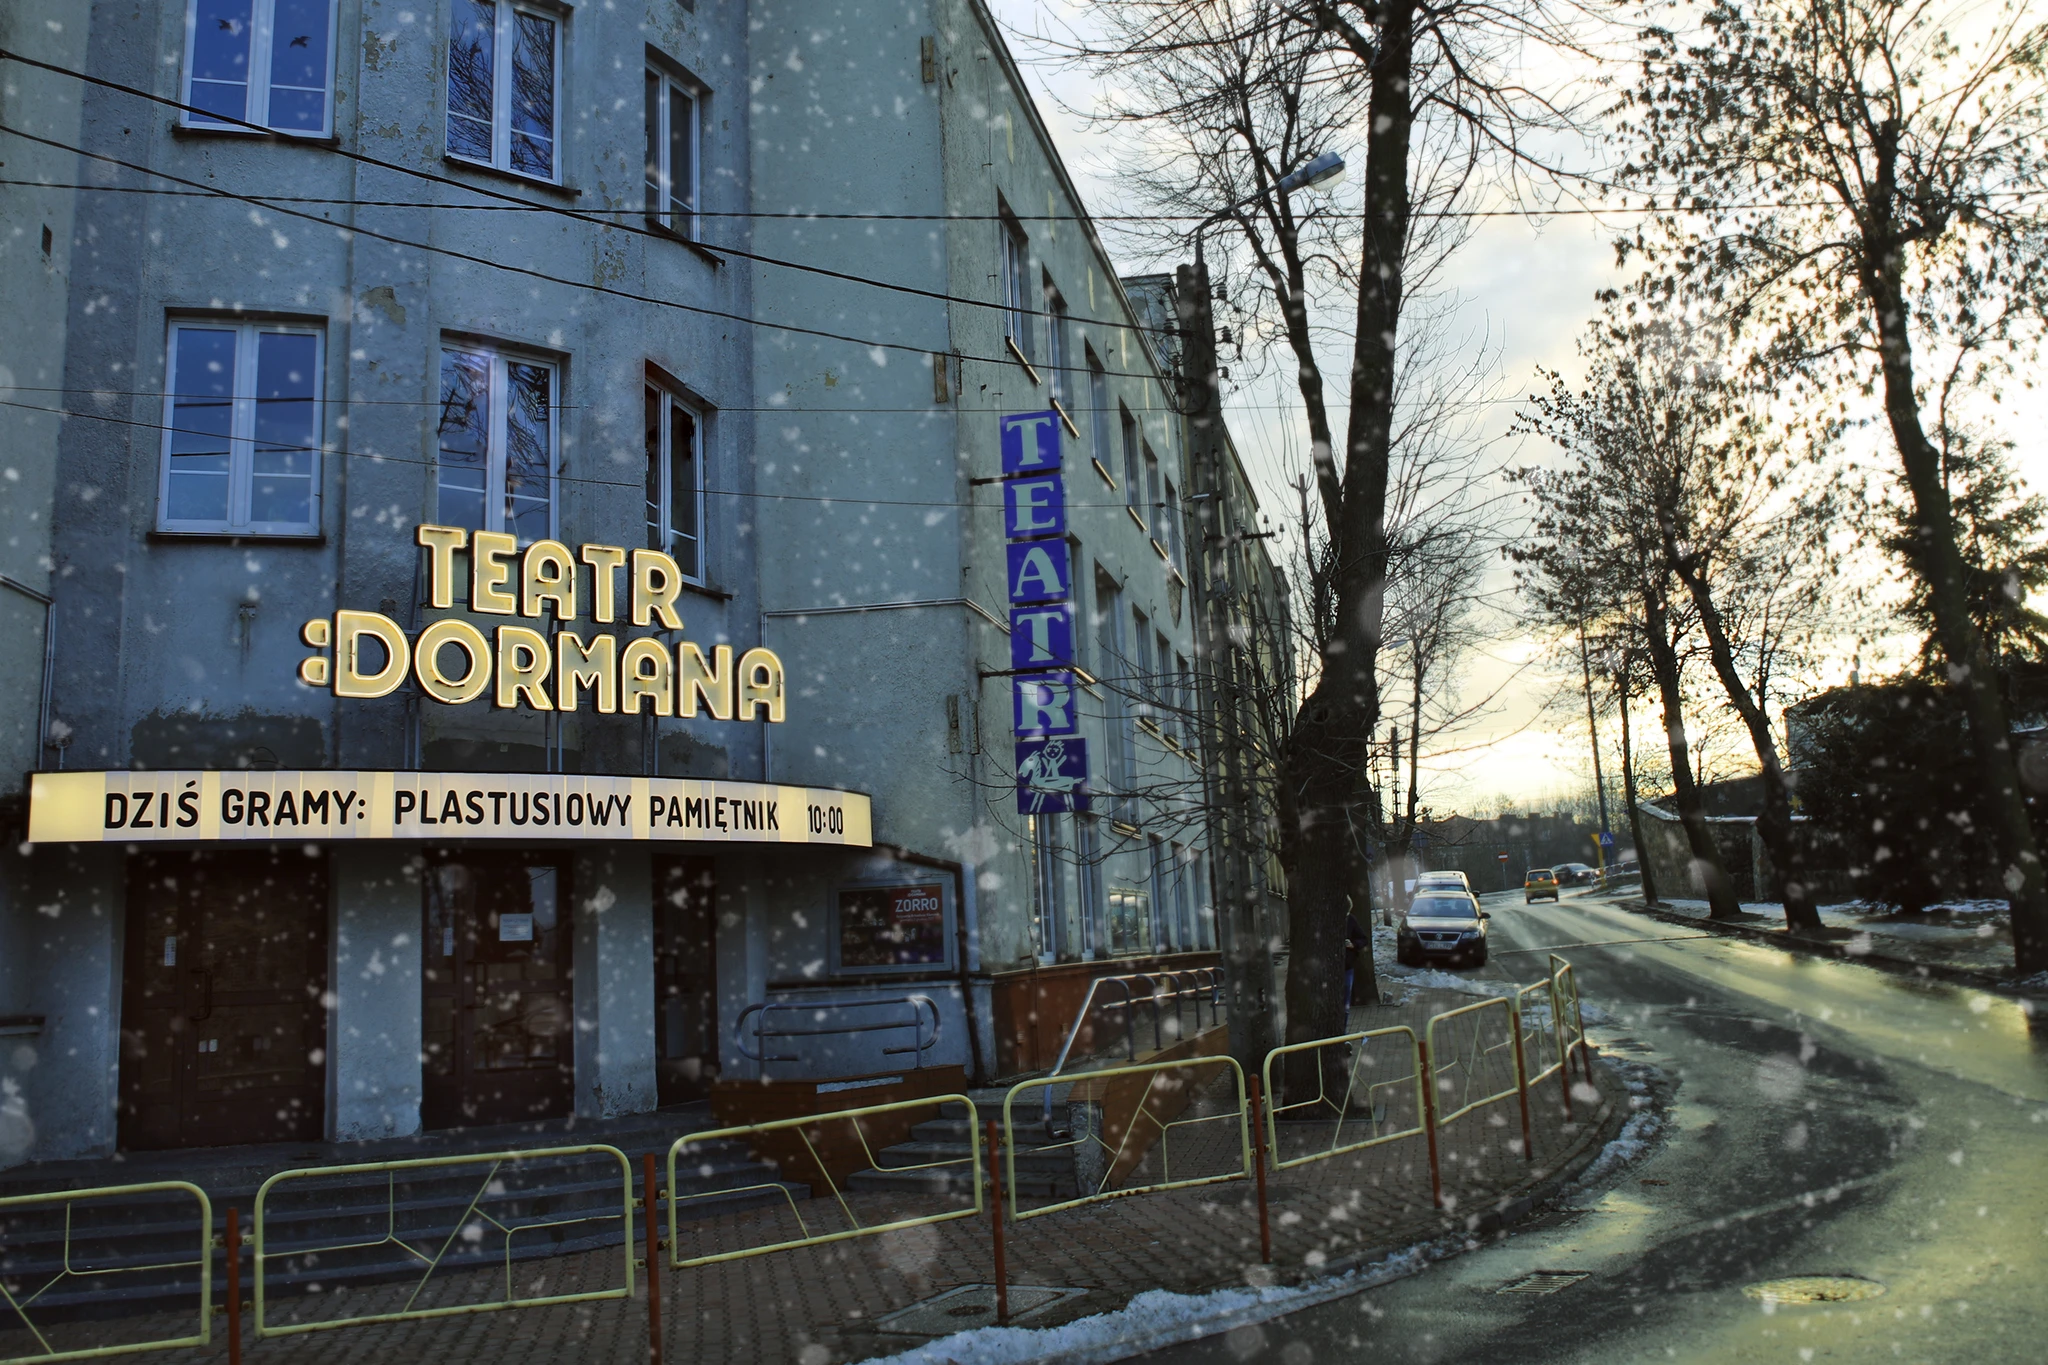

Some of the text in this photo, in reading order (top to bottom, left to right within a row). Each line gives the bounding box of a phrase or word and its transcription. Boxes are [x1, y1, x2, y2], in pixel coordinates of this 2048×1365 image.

[417, 523, 685, 631] TEATR
[1005, 416, 1071, 731] TEATR
[104, 780, 845, 835] DZIŚ GRAMY: PLASTUSIOWY PAMIĘTNIK 10:00
[894, 897, 939, 913] ZORRO
